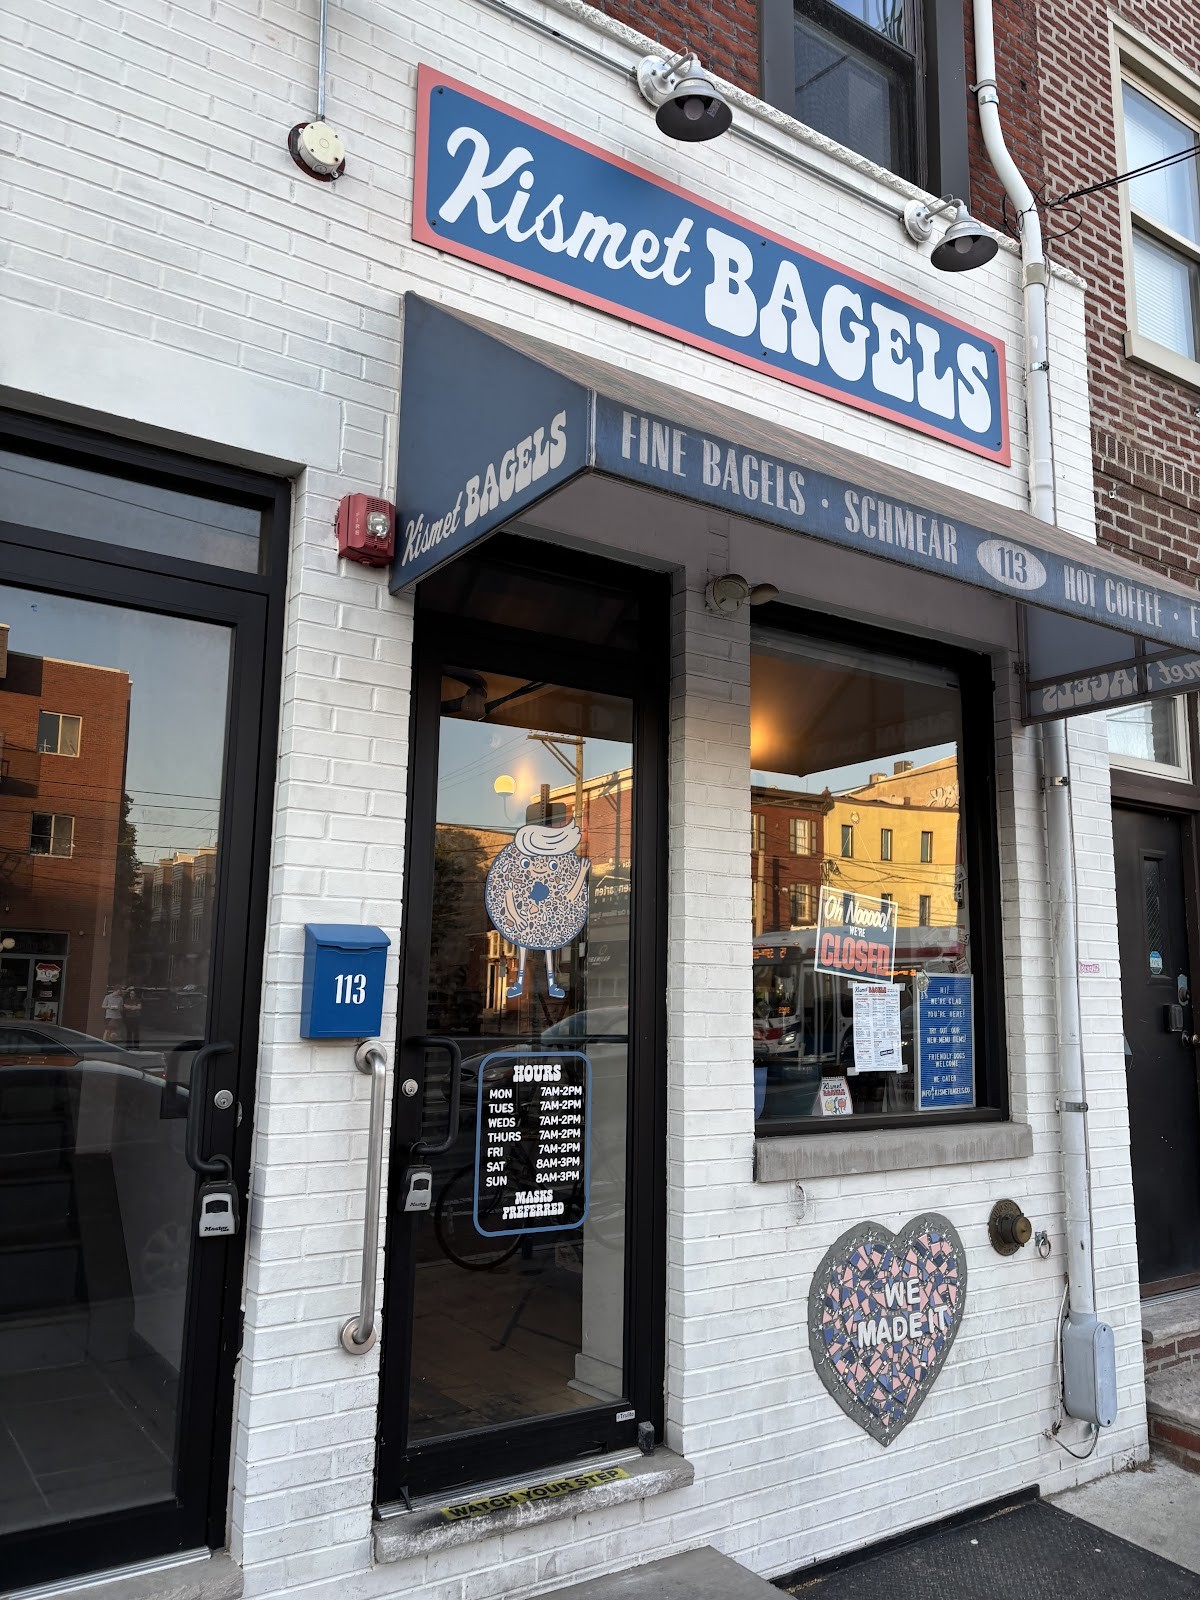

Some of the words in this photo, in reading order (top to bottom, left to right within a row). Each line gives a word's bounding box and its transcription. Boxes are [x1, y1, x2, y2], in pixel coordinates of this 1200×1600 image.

[439, 126, 694, 286] Kismet
[704, 227, 993, 434] BAGELS
[401, 490, 462, 567] Kismet
[464, 410, 567, 527] BAGELS
[621, 411, 688, 478] FINE
[702, 439, 805, 516] BAGELS
[844, 489, 959, 566] SCHMEAR
[998, 546, 1028, 585] 113
[1063, 564, 1097, 608] HOT
[1104, 577, 1163, 628] COFFEE
[824, 895, 844, 922] Oh
[849, 925, 866, 938] WE'RE
[820, 933, 890, 976] CLOSED
[334, 973, 367, 1005] 113
[930, 997, 946, 1005] WE'RE
[927, 1010, 946, 1018] YOU'RE
[949, 1009, 966, 1018] HERE!
[927, 1036, 937, 1044] NEW
[928, 1052, 952, 1061] FRIENDLY
[953, 1052, 966, 1060] DOGS
[935, 1060, 959, 1068] WELCOME
[513, 1064, 562, 1083] HOURS
[489, 1088, 513, 1099] MON
[540, 1086, 582, 1097] 7AM-2PM
[489, 1103, 514, 1114] TUES
[540, 1099, 582, 1111] 7AM-2PM
[488, 1117, 516, 1128] WEDS
[539, 1114, 581, 1126] 7AM-2PM
[487, 1131, 522, 1143] THURS
[539, 1128, 581, 1140] 7AM-2PM
[487, 1147, 503, 1157] FRI
[538, 1142, 580, 1154] 7AM-2PM
[486, 1161, 506, 1172] SAT
[536, 1156, 580, 1169] 8AM-3PM
[486, 1175, 508, 1187] SUN
[535, 1170, 580, 1183] 8AM-3PM
[514, 1189, 554, 1205] MASKS
[502, 1202, 565, 1220] PREFERRED
[885, 1278, 922, 1308] WE
[857, 1313, 923, 1348] MADE
[928, 1305, 949, 1333] IT
[448, 1495, 519, 1517] WATCH
[519, 1481, 574, 1499] YOUR
[574, 1470, 619, 1486] STEP
